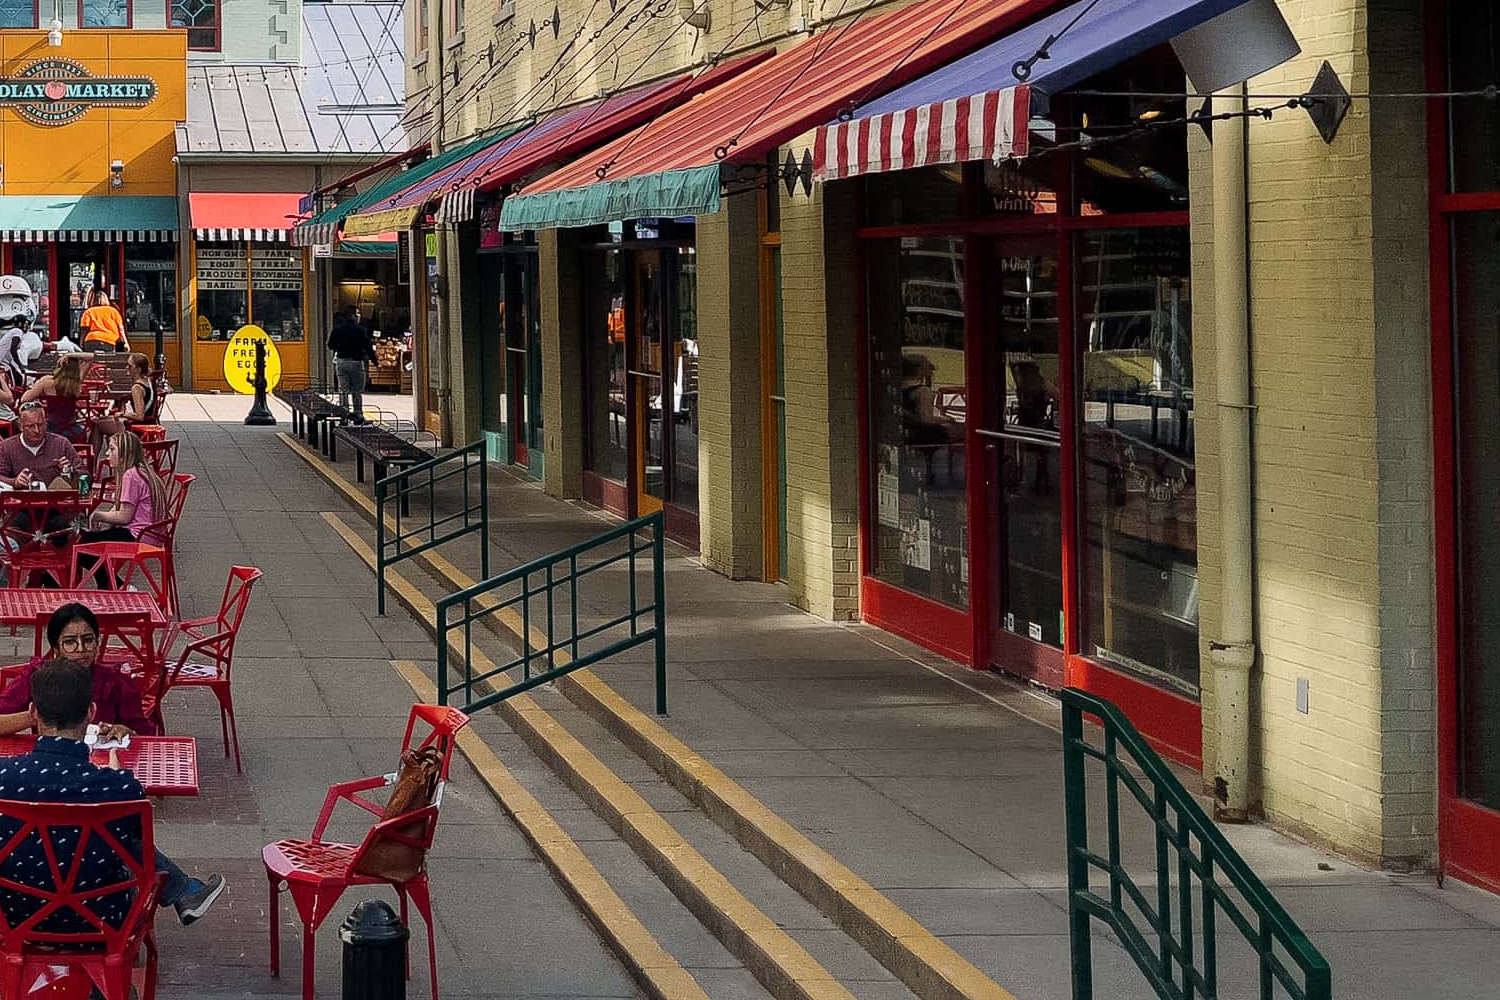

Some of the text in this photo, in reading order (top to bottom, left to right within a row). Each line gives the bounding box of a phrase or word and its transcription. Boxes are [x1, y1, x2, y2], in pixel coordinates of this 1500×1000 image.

[26, 61, 55, 76] SINCE
[65, 84, 150, 98] MARKET
[26, 105, 83, 120] CINCINNATI
[233, 349, 270, 357] FREH
